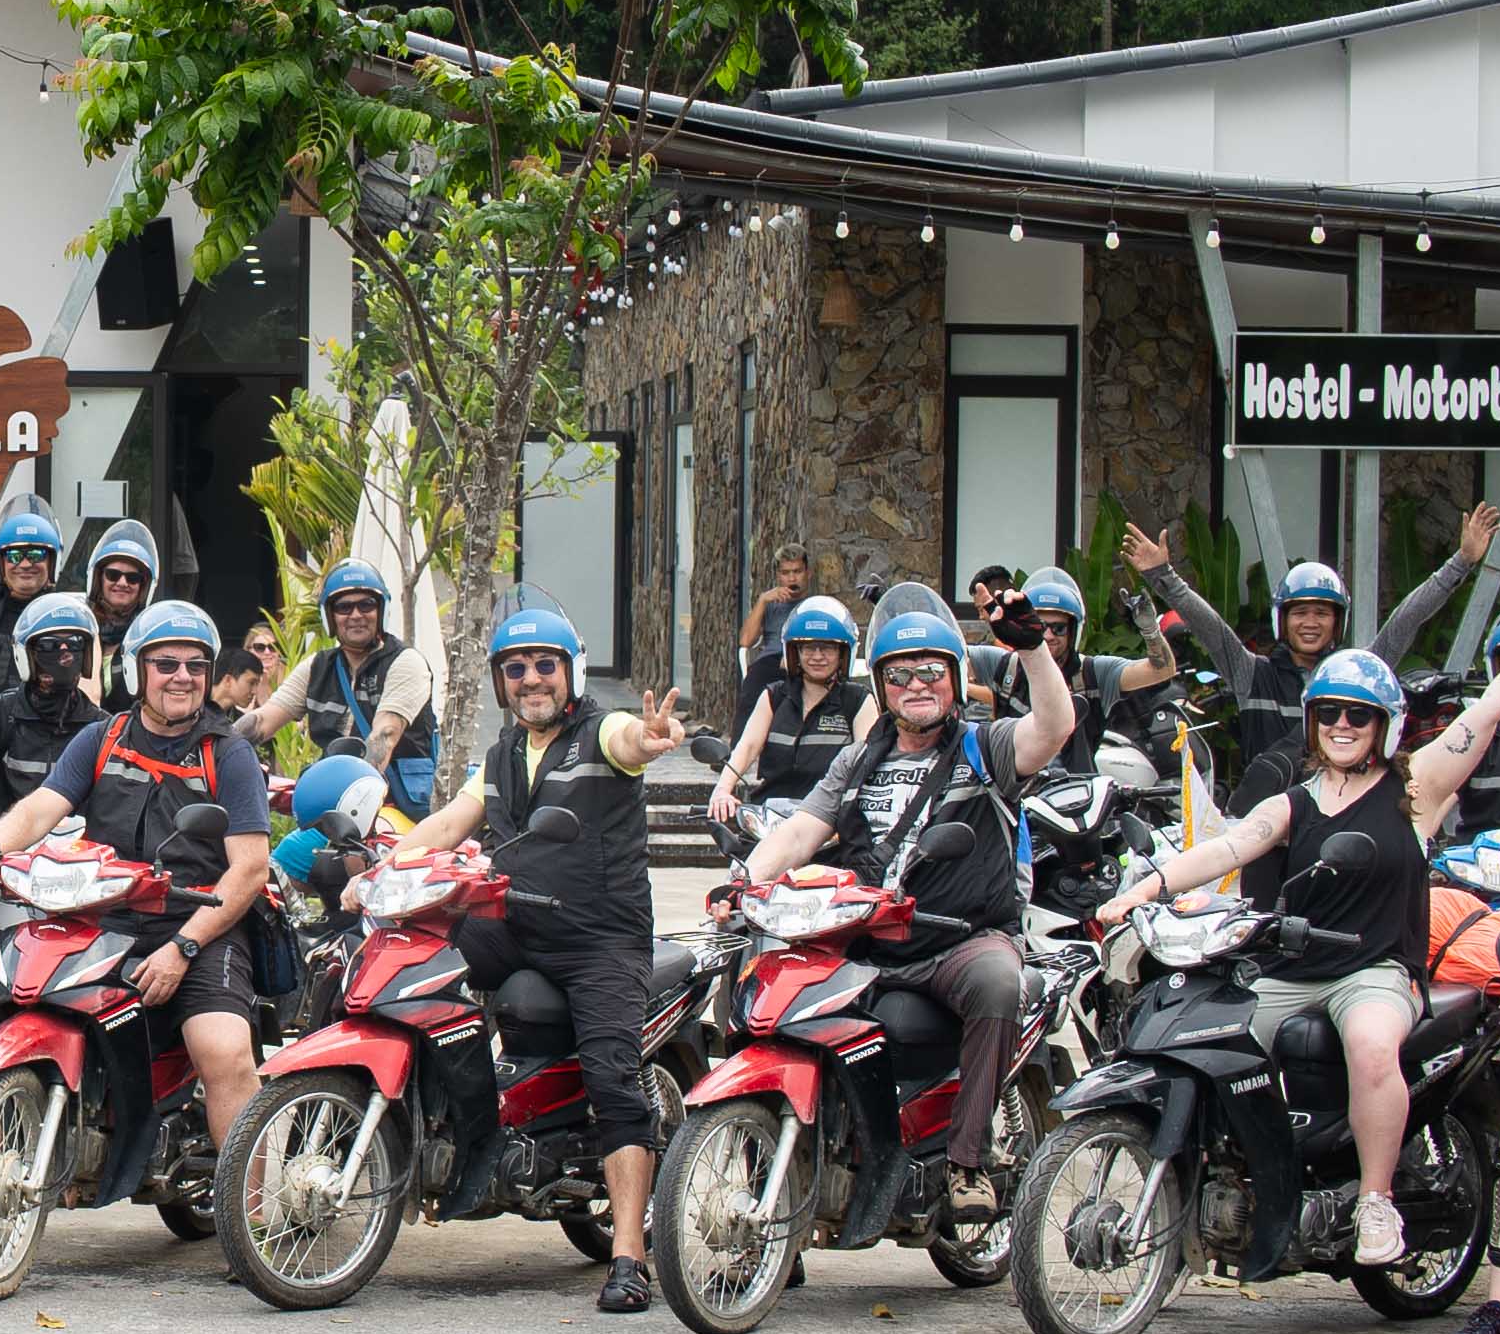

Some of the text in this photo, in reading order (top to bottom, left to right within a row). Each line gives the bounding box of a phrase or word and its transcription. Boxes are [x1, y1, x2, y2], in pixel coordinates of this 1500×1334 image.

[1244, 363, 1351, 420] Hostel
[104, 1010, 139, 1031] HONDA
[437, 1027, 478, 1047] HONDA
[844, 1044, 883, 1065] HONDA
[1230, 1072, 1272, 1095] YAMAHA
